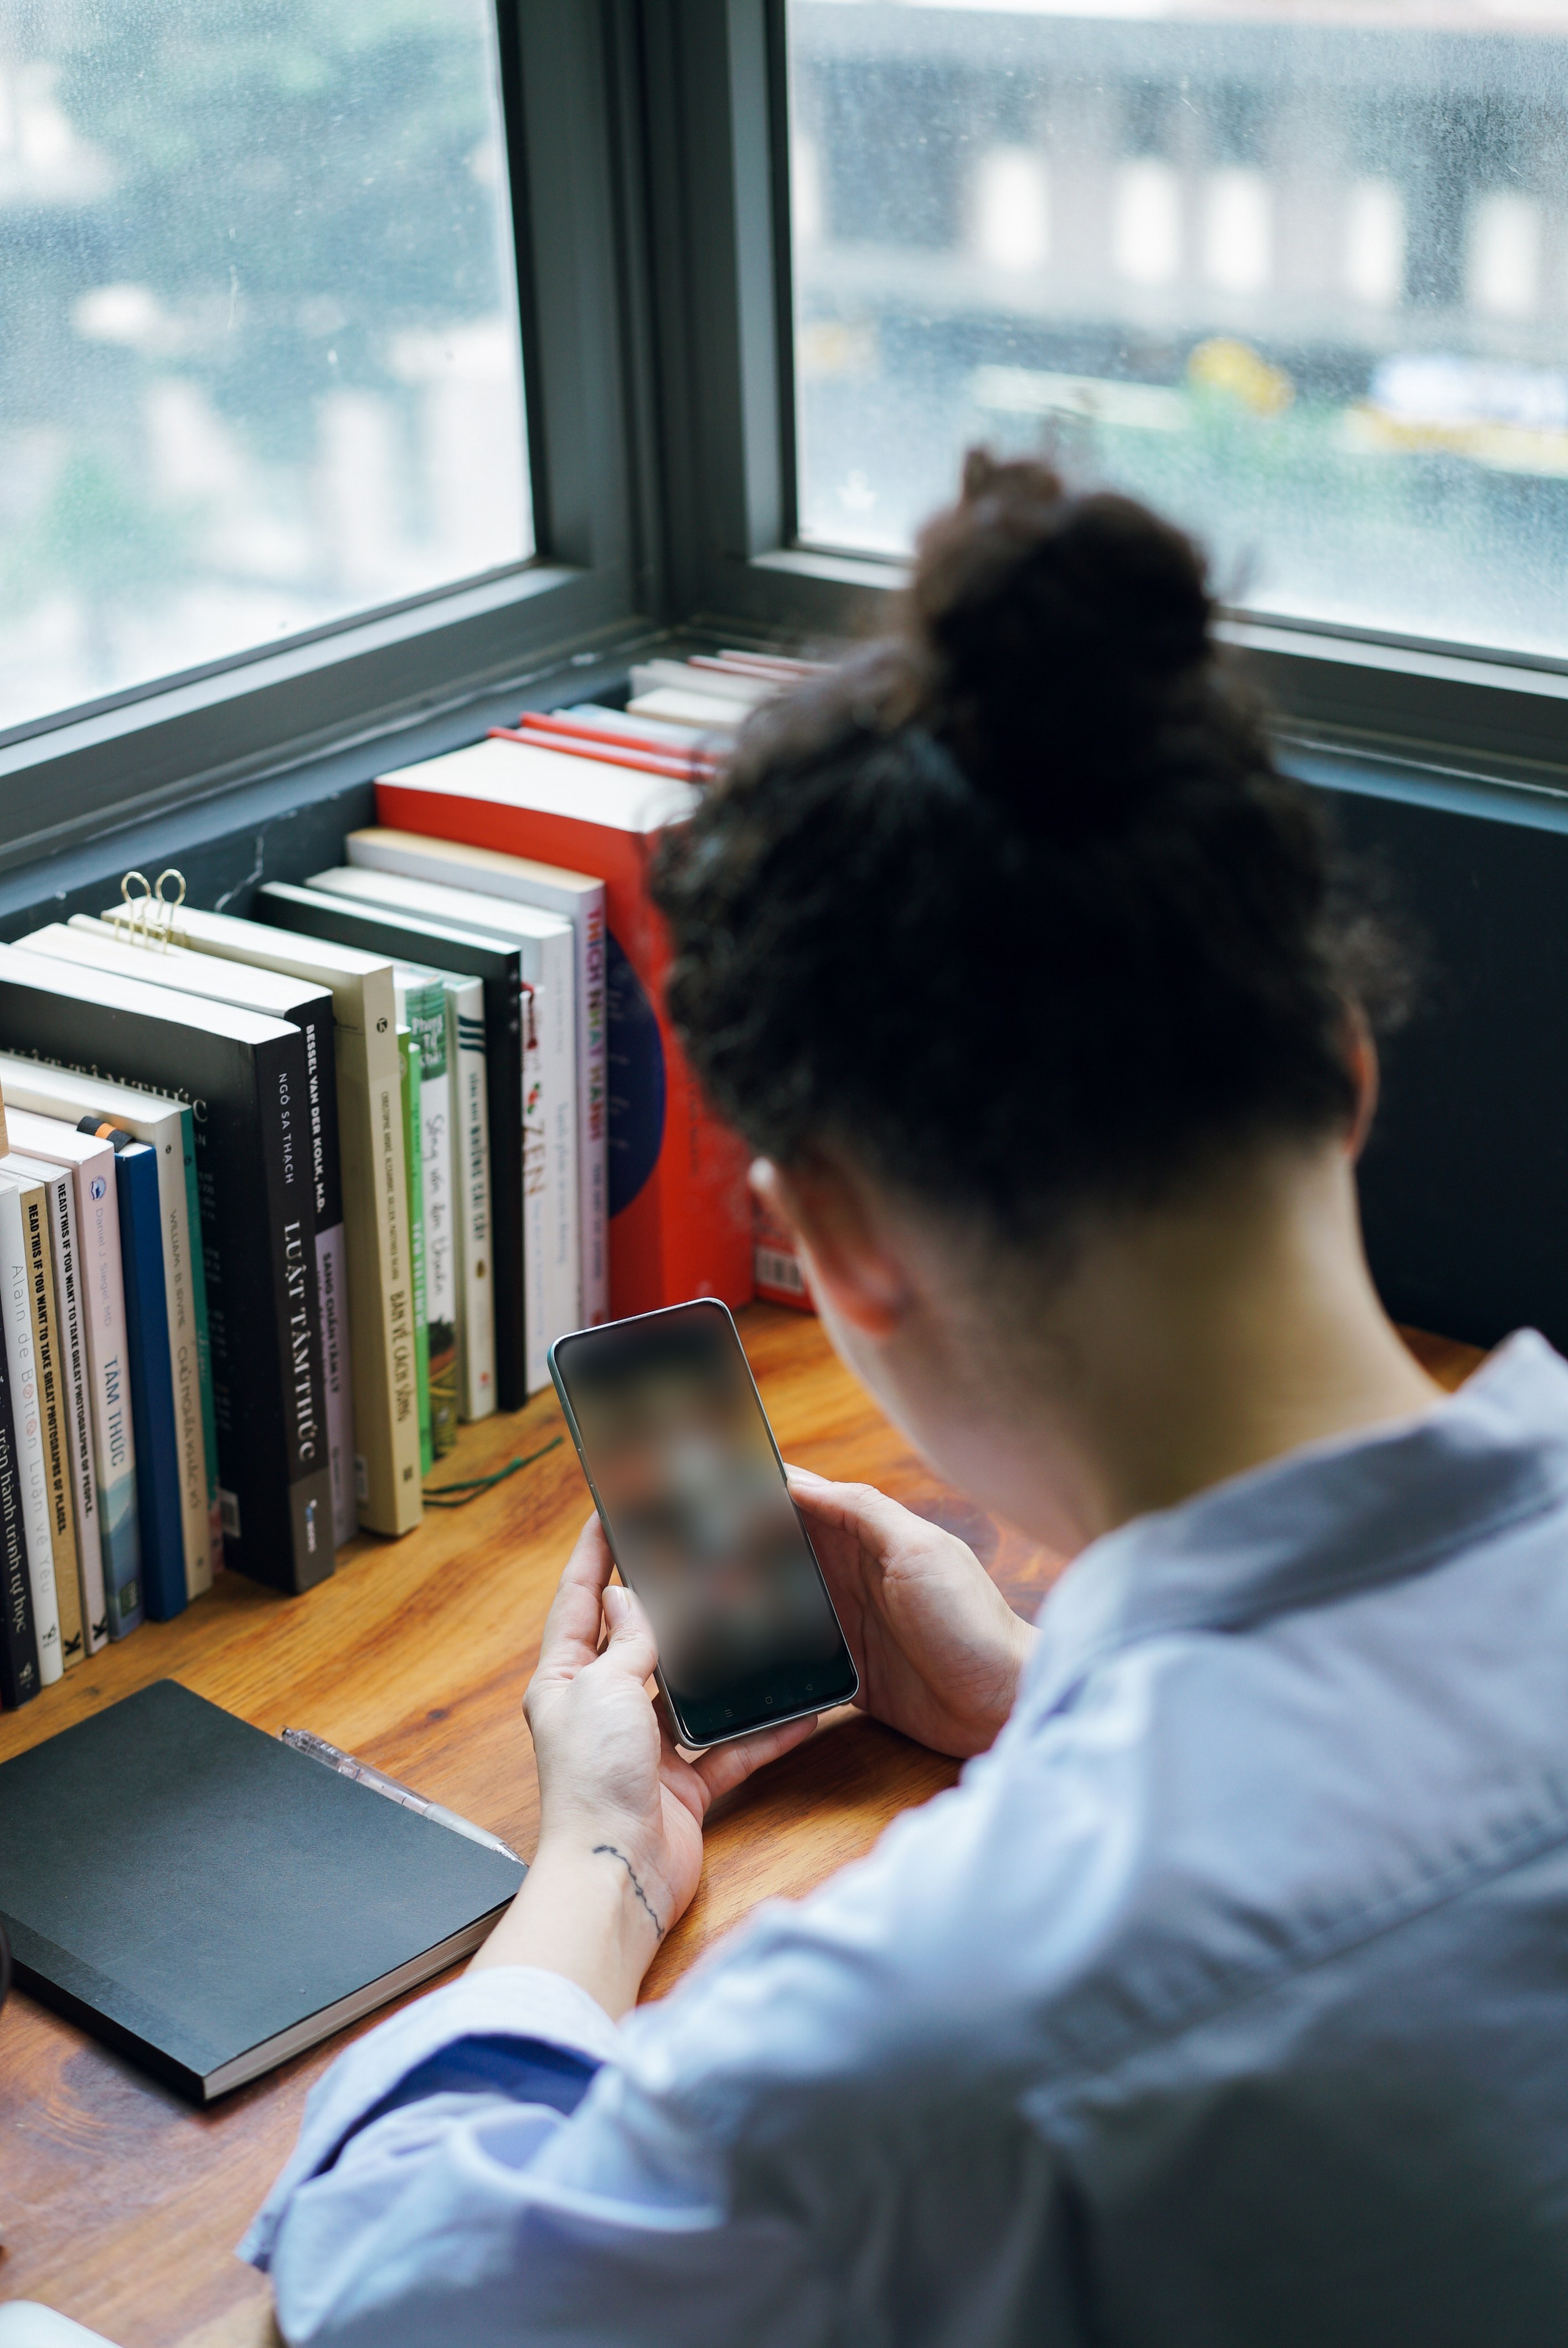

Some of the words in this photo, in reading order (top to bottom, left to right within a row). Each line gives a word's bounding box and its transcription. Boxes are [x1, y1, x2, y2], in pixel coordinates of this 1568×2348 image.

[306, 1024, 317, 1074] BESSEL
[278, 1073, 291, 1105] NGÔ
[310, 1075, 318, 1104] VAN
[281, 1111, 291, 1129] SA
[311, 1106, 321, 1134] DER
[283, 1133, 295, 1184] THẠCH
[313, 1137, 324, 1181] KOLK,
[524, 1119, 548, 1197] ZEN
[58, 1183, 68, 1212] READ
[316, 1183, 325, 1213] M.D.
[28, 1203, 39, 1232] READ
[60, 1213, 69, 1237] THIS
[95, 1207, 106, 1247] Daniel
[32, 1233, 42, 1258] THIS
[63, 1239, 70, 1250] IF
[169, 1209, 181, 1267] WILLIAM
[34, 1259, 43, 1270] IF
[64, 1252, 73, 1273] YOU
[99, 1251, 107, 1260] J.
[284, 1221, 307, 1299] LUẬT
[34, 1272, 44, 1293] YOU
[66, 1274, 76, 1304] WANT
[323, 1253, 332, 1295] SANG
[12, 1265, 27, 1321] Alain
[37, 1294, 47, 1325] WANT
[68, 1306, 76, 1321] TO
[104, 1307, 112, 1327] MD
[18, 1333, 31, 1358] de
[40, 1326, 48, 1340] TO
[70, 1322, 80, 1348] TAKE
[291, 1307, 311, 1374] TÂM
[41, 1342, 51, 1369] TAKE
[72, 1351, 82, 1382] GREAT
[44, 1371, 55, 1403] GREAT
[104, 1355, 121, 1405] TÂM
[75, 1384, 88, 1456] PHOTOGRAPHS
[294, 1376, 318, 1463] THỨC
[47, 1405, 61, 1477] PHOTOGRAPHS
[109, 1407, 127, 1468] THỨC
[81, 1459, 90, 1472] OF
[0, 1470, 17, 1521] hành
[54, 1480, 63, 1491] OF
[82, 1473, 94, 1518] PEOPLE.
[55, 1493, 66, 1535] PLACES.
[6, 1524, 22, 1571] trình
[9, 1573, 24, 1595] tự
[12, 1595, 27, 1633] học
